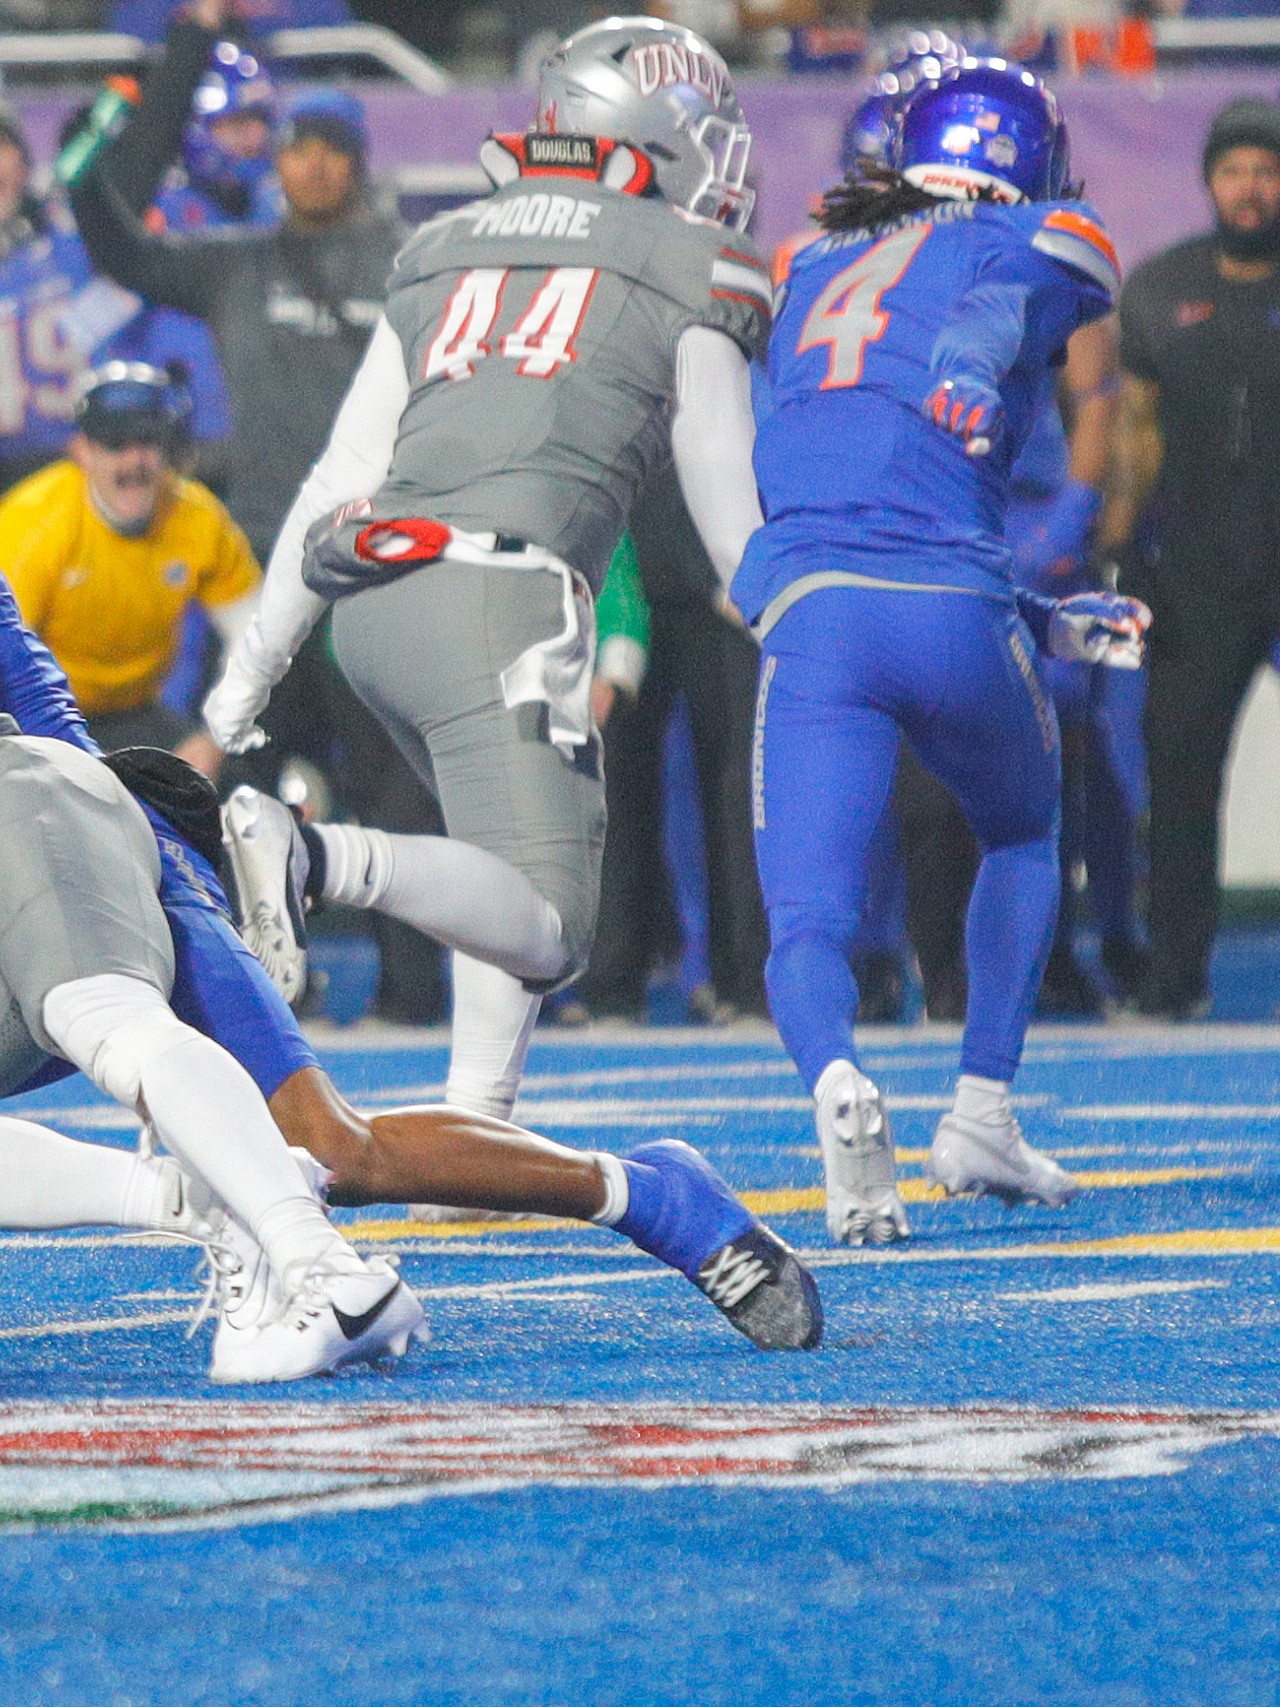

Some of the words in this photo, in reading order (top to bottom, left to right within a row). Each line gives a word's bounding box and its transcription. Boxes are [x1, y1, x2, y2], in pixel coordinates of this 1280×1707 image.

[630, 43, 724, 109] UNLV
[472, 193, 602, 238] MOORE
[421, 267, 602, 381] 44
[796, 222, 933, 390] 4
